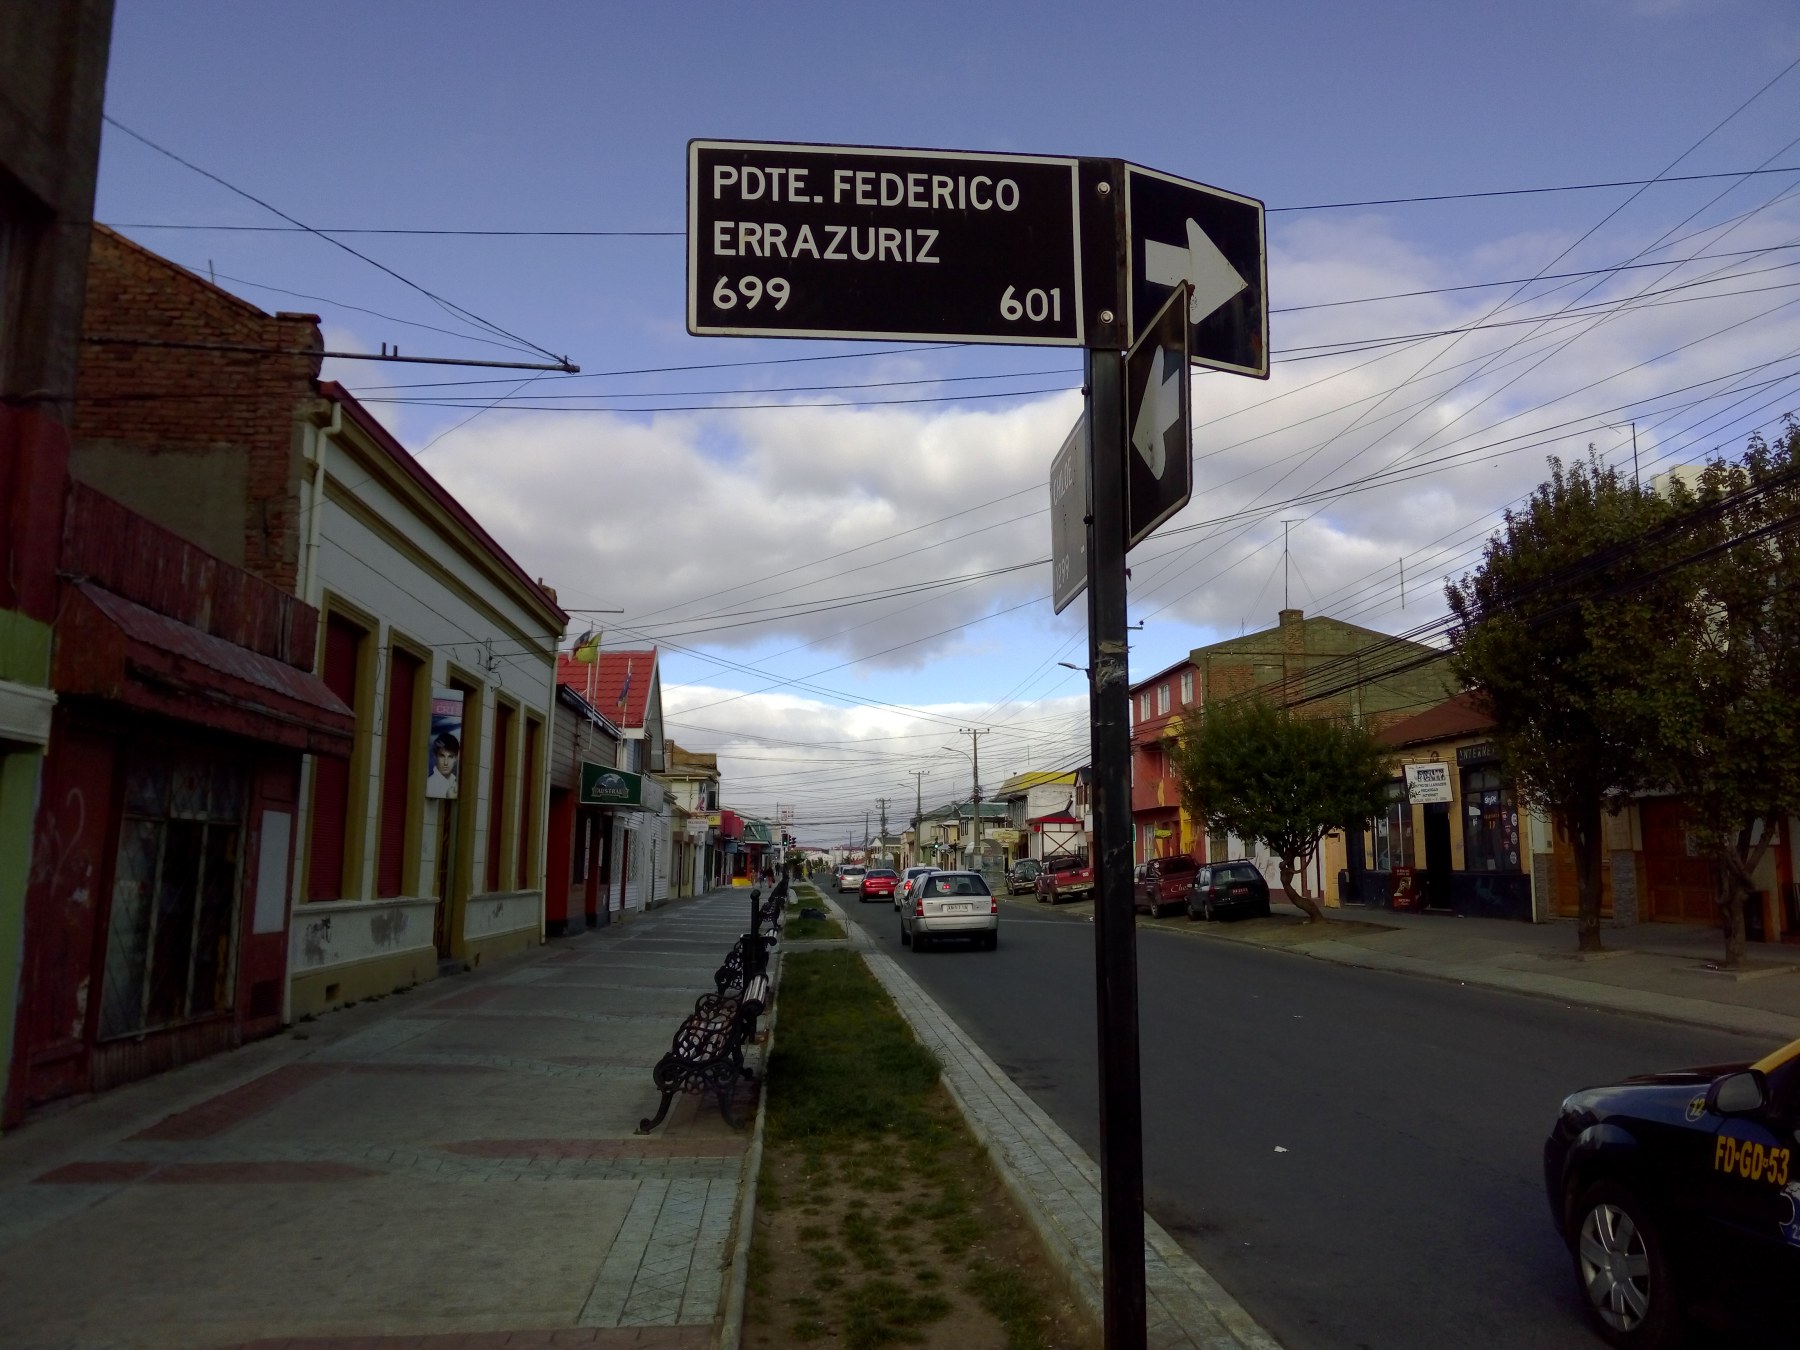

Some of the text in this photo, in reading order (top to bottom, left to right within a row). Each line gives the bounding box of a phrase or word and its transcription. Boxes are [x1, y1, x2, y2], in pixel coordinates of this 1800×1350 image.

[713, 164, 1020, 212] PDTE. FEDERICO
[713, 220, 941, 264] ERRAZURIZ
[712, 275, 1062, 322] 699 601
